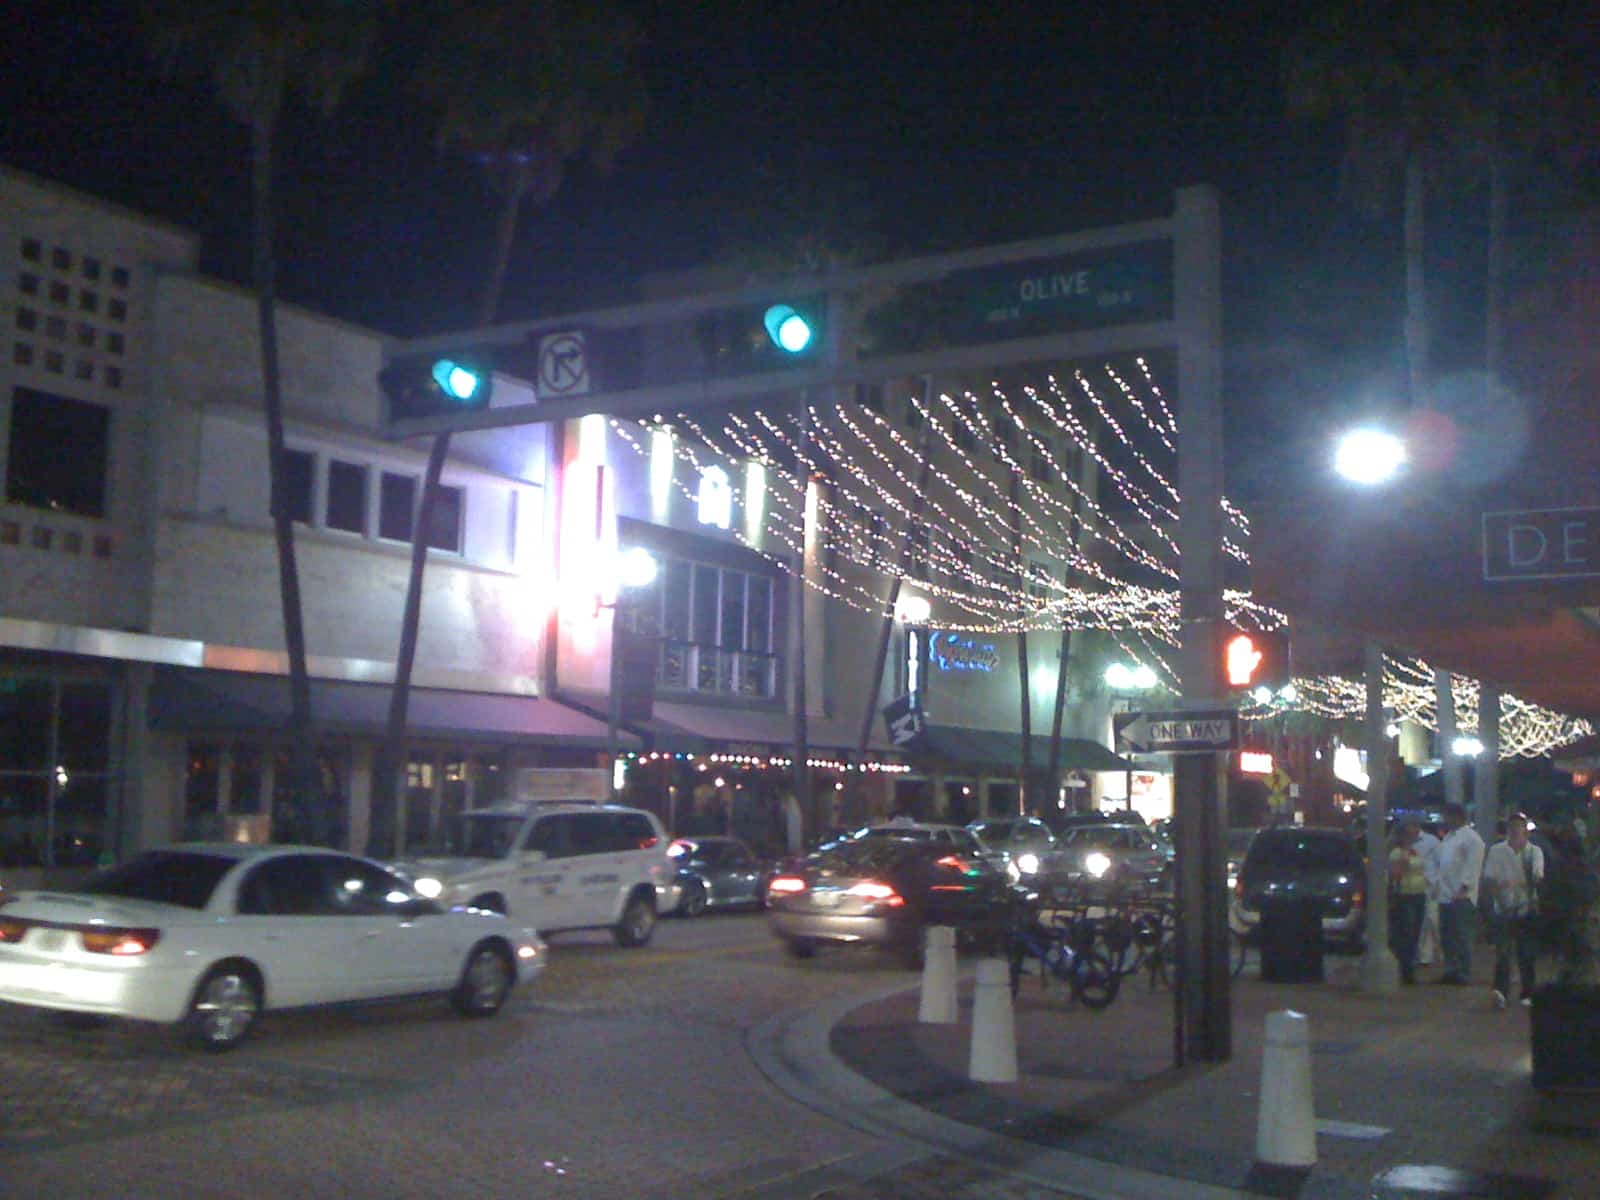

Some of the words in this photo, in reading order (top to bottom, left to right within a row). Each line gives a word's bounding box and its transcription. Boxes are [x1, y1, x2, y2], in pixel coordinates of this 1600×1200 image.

[1020, 271, 1090, 301] OLIVE
[1151, 720, 1181, 740] ONE
[1184, 719, 1222, 739] WAY
